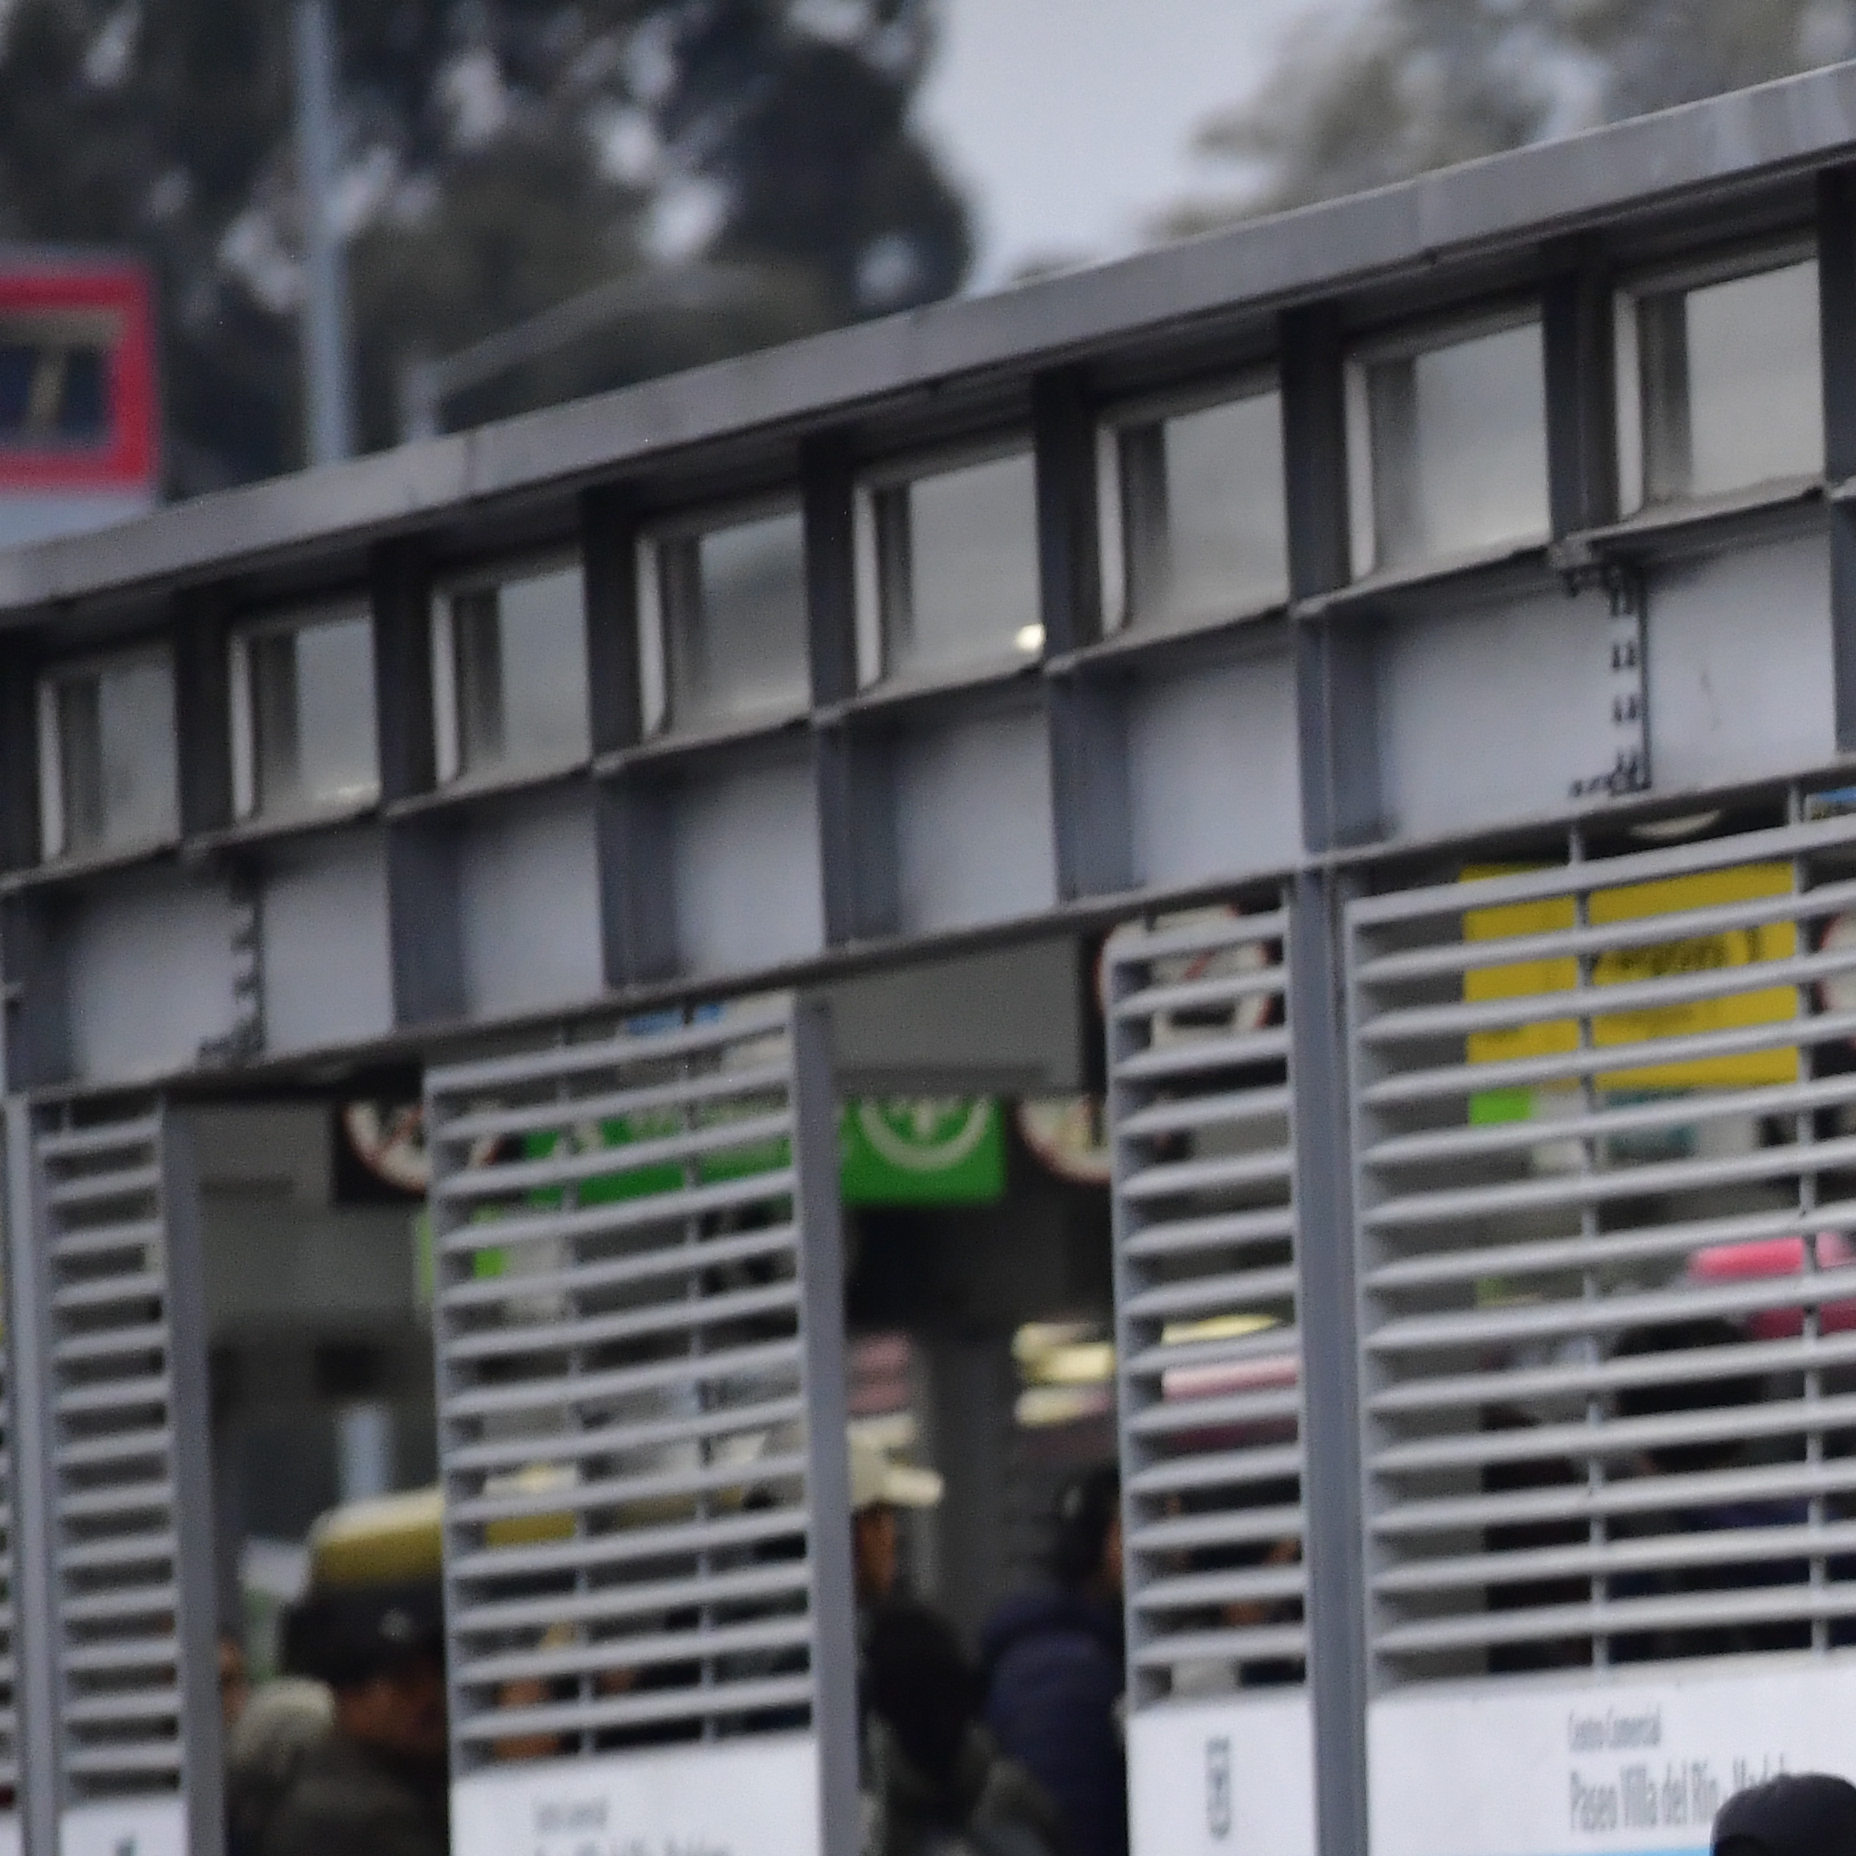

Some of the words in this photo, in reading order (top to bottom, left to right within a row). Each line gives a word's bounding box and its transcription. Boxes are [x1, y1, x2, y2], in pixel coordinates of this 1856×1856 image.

[1569, 1767, 1617, 1832] Paseo
[1620, 1763, 1657, 1828] Villa
[1662, 1760, 1688, 1825] del
